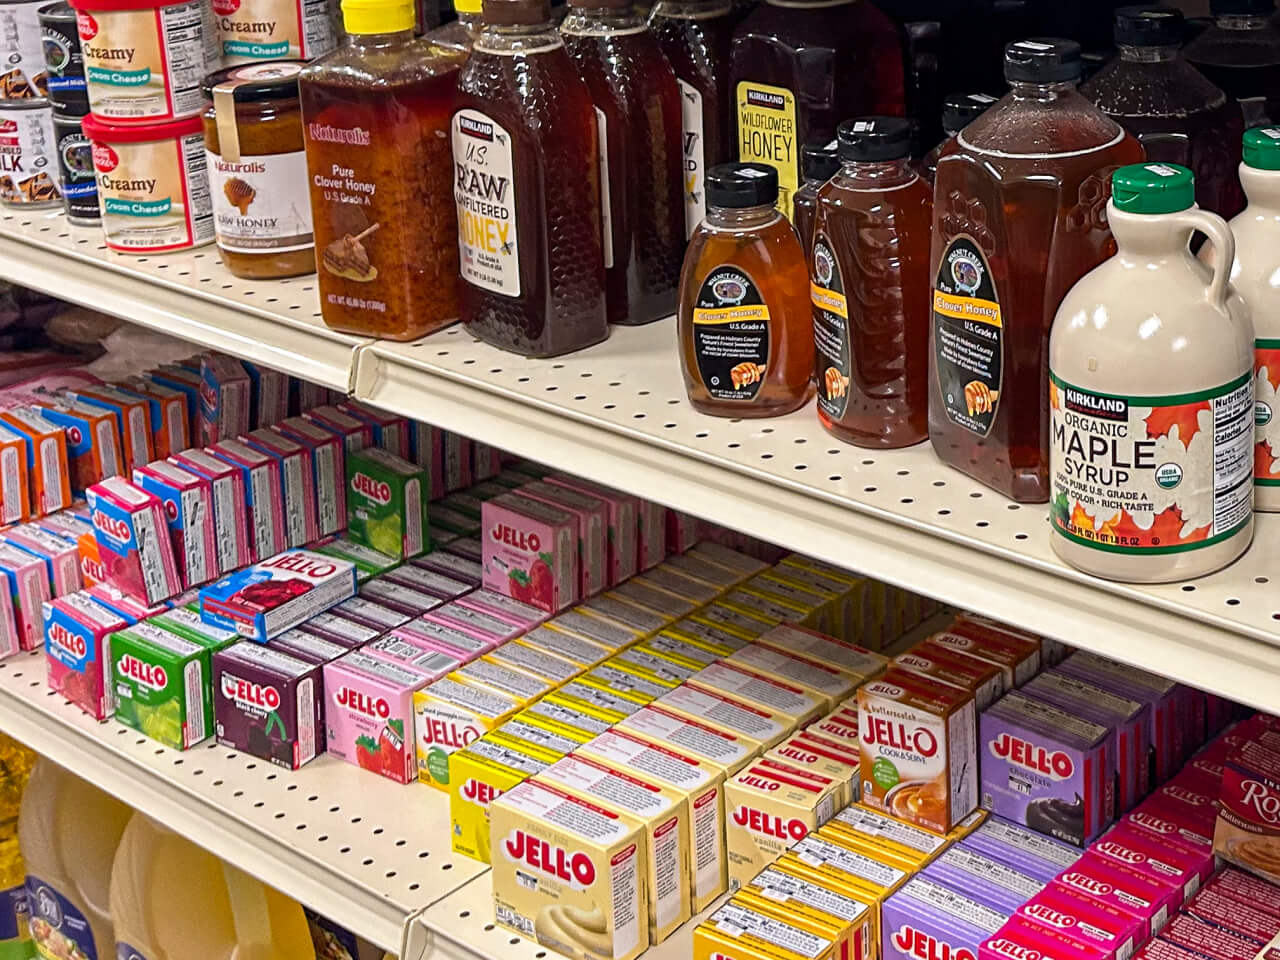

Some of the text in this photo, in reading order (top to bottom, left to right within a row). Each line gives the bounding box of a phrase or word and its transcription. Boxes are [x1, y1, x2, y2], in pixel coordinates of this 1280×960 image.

[84, 44, 135, 63] Creamy
[111, 72, 149, 83] Cheese
[749, 92, 784, 104] KIRKLAND
[460, 118, 492, 135] KIRKLAND
[741, 112, 793, 133] WILDFLOWER
[466, 142, 488, 166] U.S.
[743, 130, 793, 162] HONEY
[332, 165, 354, 178] Pure
[102, 174, 156, 193] Creamy
[314, 176, 375, 195] Clover Honey
[457, 163, 511, 203] RAW
[455, 190, 509, 219] UNFILTERED
[936, 297, 998, 320] Clover Honey
[1067, 389, 1126, 413] KIRKLAND
[1065, 412, 1127, 437] ORGANIC
[1053, 415, 1156, 469] MAPLE
[1065, 457, 1129, 488] SYRUP
[1070, 479, 1088, 492] PURE
[1089, 485, 1105, 496] U.S.
[1107, 490, 1139, 500] GRADE
[1101, 500, 1154, 512] RICH TASTE
[349, 714, 378, 729] strawberry
[1010, 767, 1050, 787] chocolate
